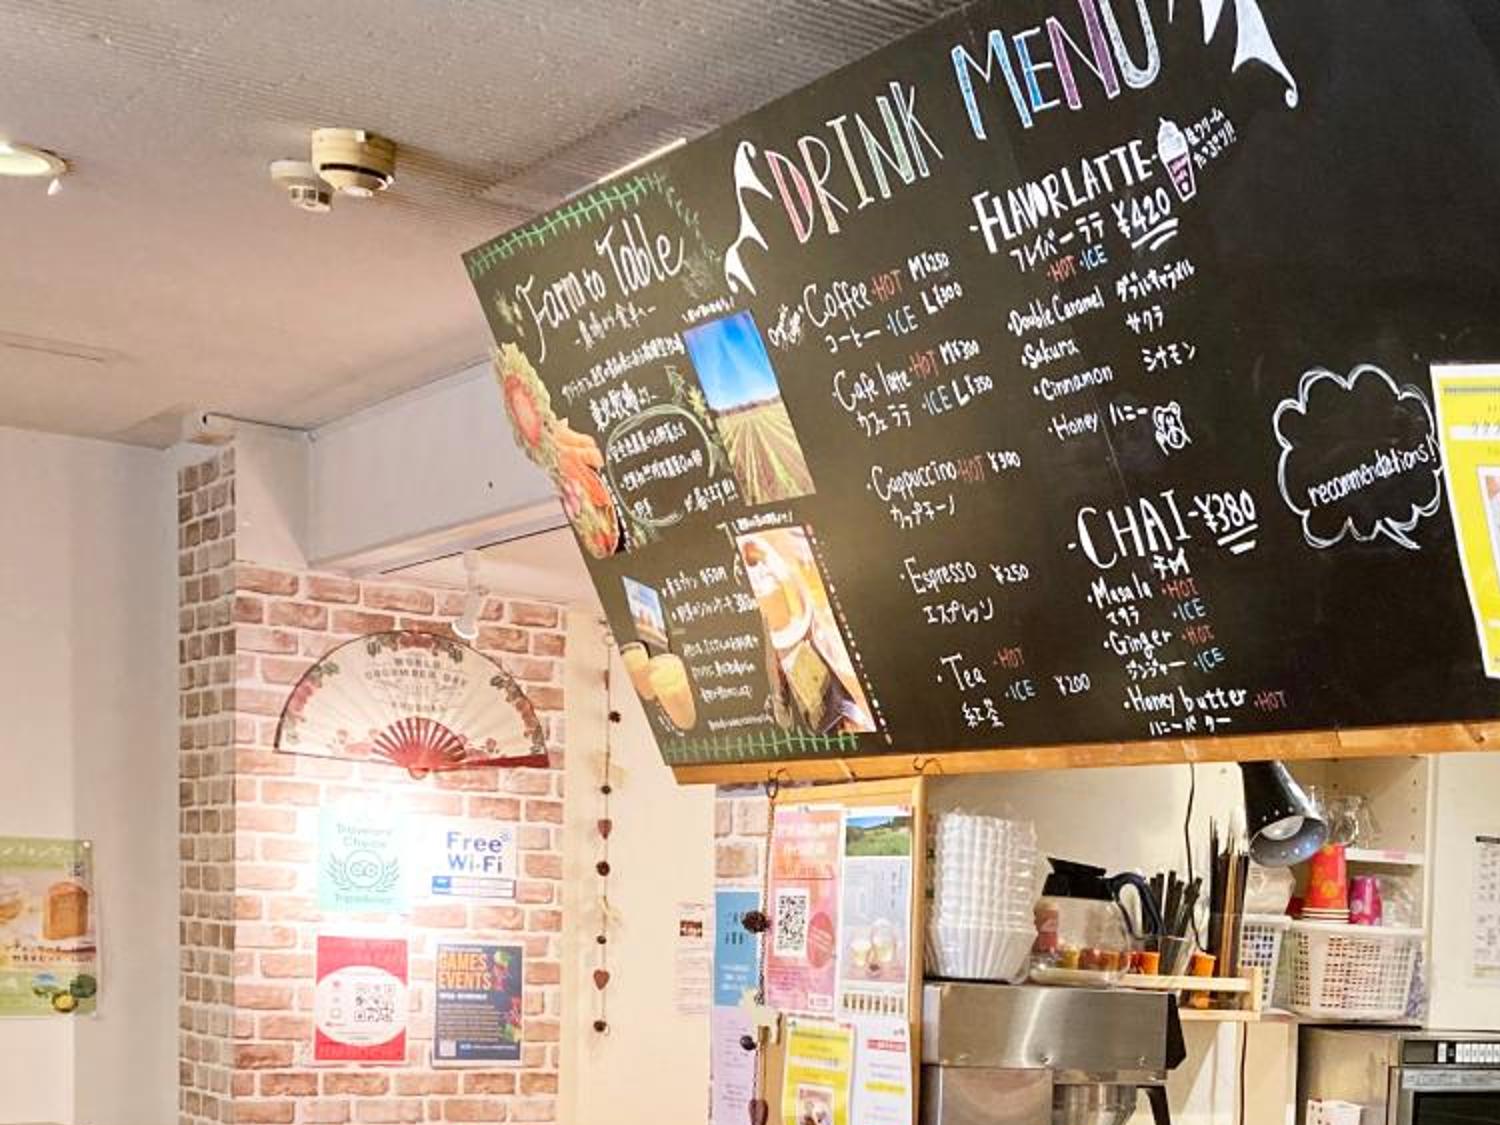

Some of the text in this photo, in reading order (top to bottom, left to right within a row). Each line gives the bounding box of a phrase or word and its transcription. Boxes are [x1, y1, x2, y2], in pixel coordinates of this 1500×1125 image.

[764, 0, 1161, 244] DRINK MENU
[972, 140, 1153, 253] FLAVOR LATTE
[1111, 187, 1172, 239] ¥420
[1050, 244, 1109, 283] HOT ICE
[515, 213, 685, 363] Farm to Table
[803, 280, 873, 329] Coffee
[873, 269, 901, 302] HOT
[888, 305, 919, 337] ICE
[1125, 305, 1165, 335] サクラ
[911, 349, 940, 380] HOT
[1023, 337, 1081, 370] Sakura
[1040, 365, 1115, 401] Cinnamon
[925, 385, 954, 416] ICE
[1051, 411, 1099, 441] Honey
[872, 460, 958, 502] Cappuccino
[1077, 488, 1257, 569] CHAI ¥380
[903, 556, 978, 595] Espresso
[1091, 573, 1201, 610] Masala HOT
[1176, 598, 1207, 621] ICE
[1109, 625, 1216, 661] Ginger HOT
[940, 653, 987, 691] Tea
[1196, 648, 1226, 673] ICE
[1009, 679, 1037, 702] ICE
[1126, 684, 1177, 716] Honey
[1178, 686, 1249, 713] butter
[446, 830, 503, 854] Free
[447, 853, 504, 874] Wi-Fi
[439, 971, 492, 991] EVENTS
